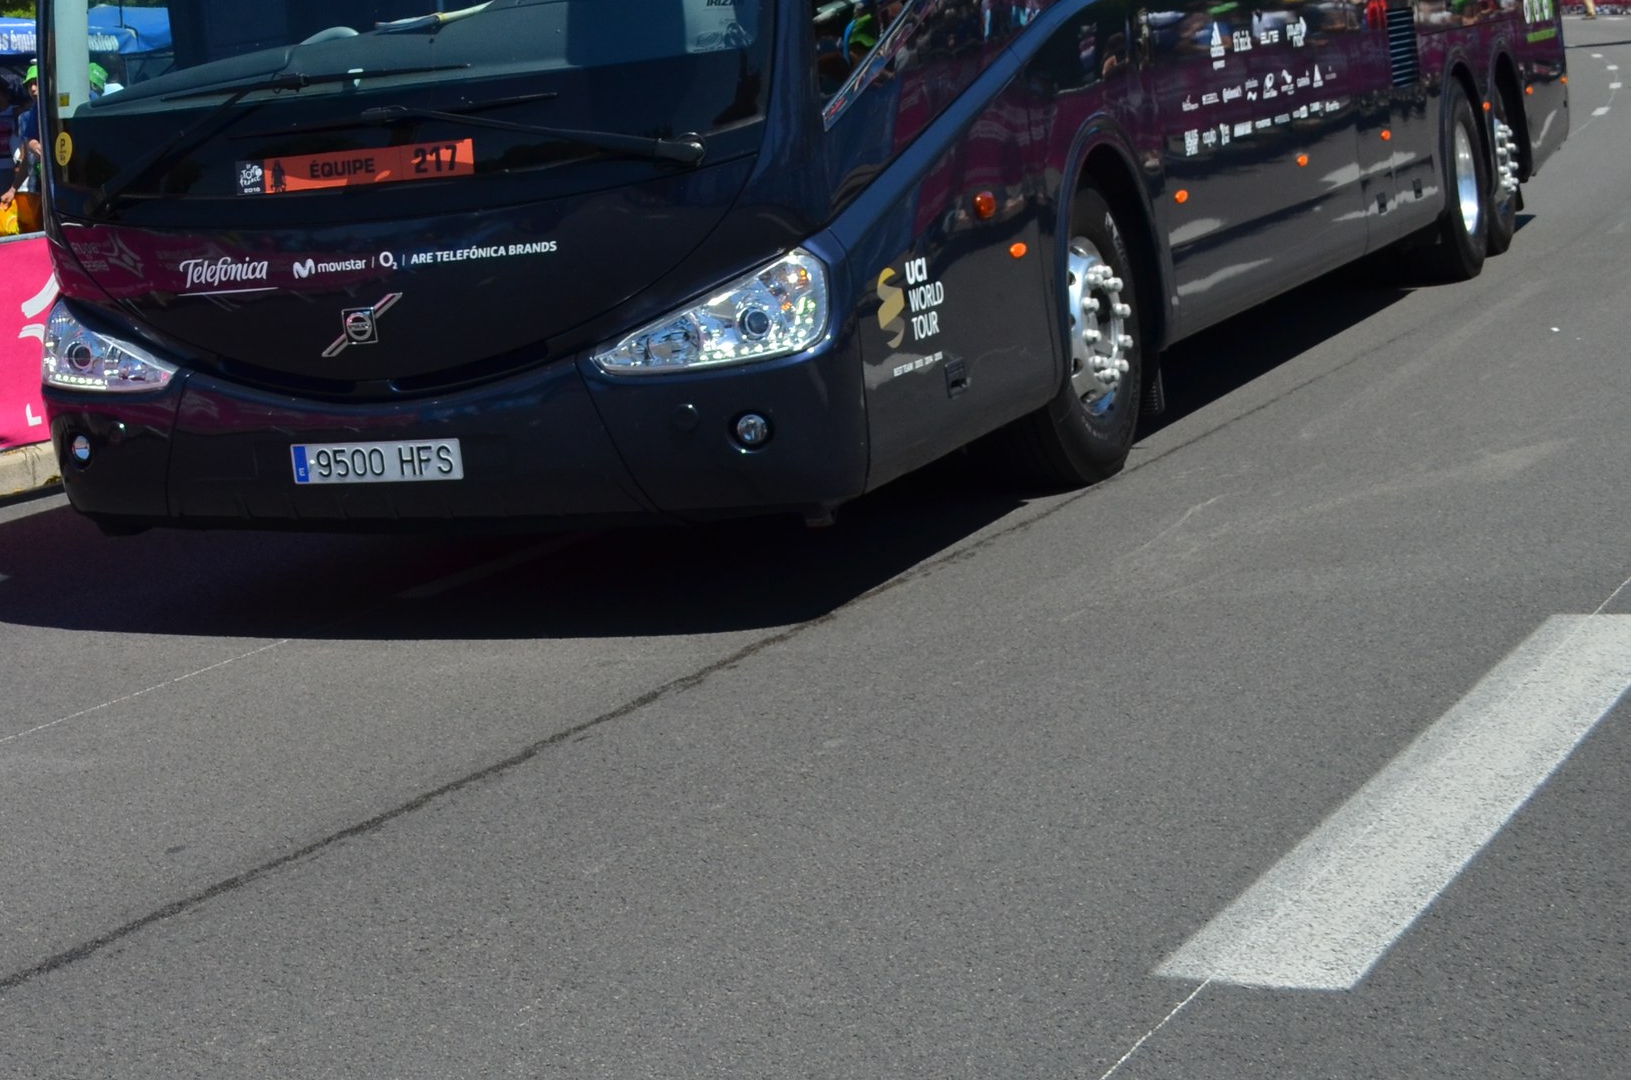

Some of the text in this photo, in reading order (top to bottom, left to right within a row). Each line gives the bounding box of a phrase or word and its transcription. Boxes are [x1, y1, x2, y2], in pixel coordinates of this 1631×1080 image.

[309, 144, 457, 179] ÉQUIPE 217
[317, 259, 367, 273] movistar
[410, 241, 557, 265] ARE TELEFÓNICA BRANDS
[905, 257, 928, 285] UCI
[908, 281, 944, 313] WORLD
[911, 311, 940, 341] TOUR
[316, 448, 386, 478] 9500
[397, 444, 454, 476] HFS
